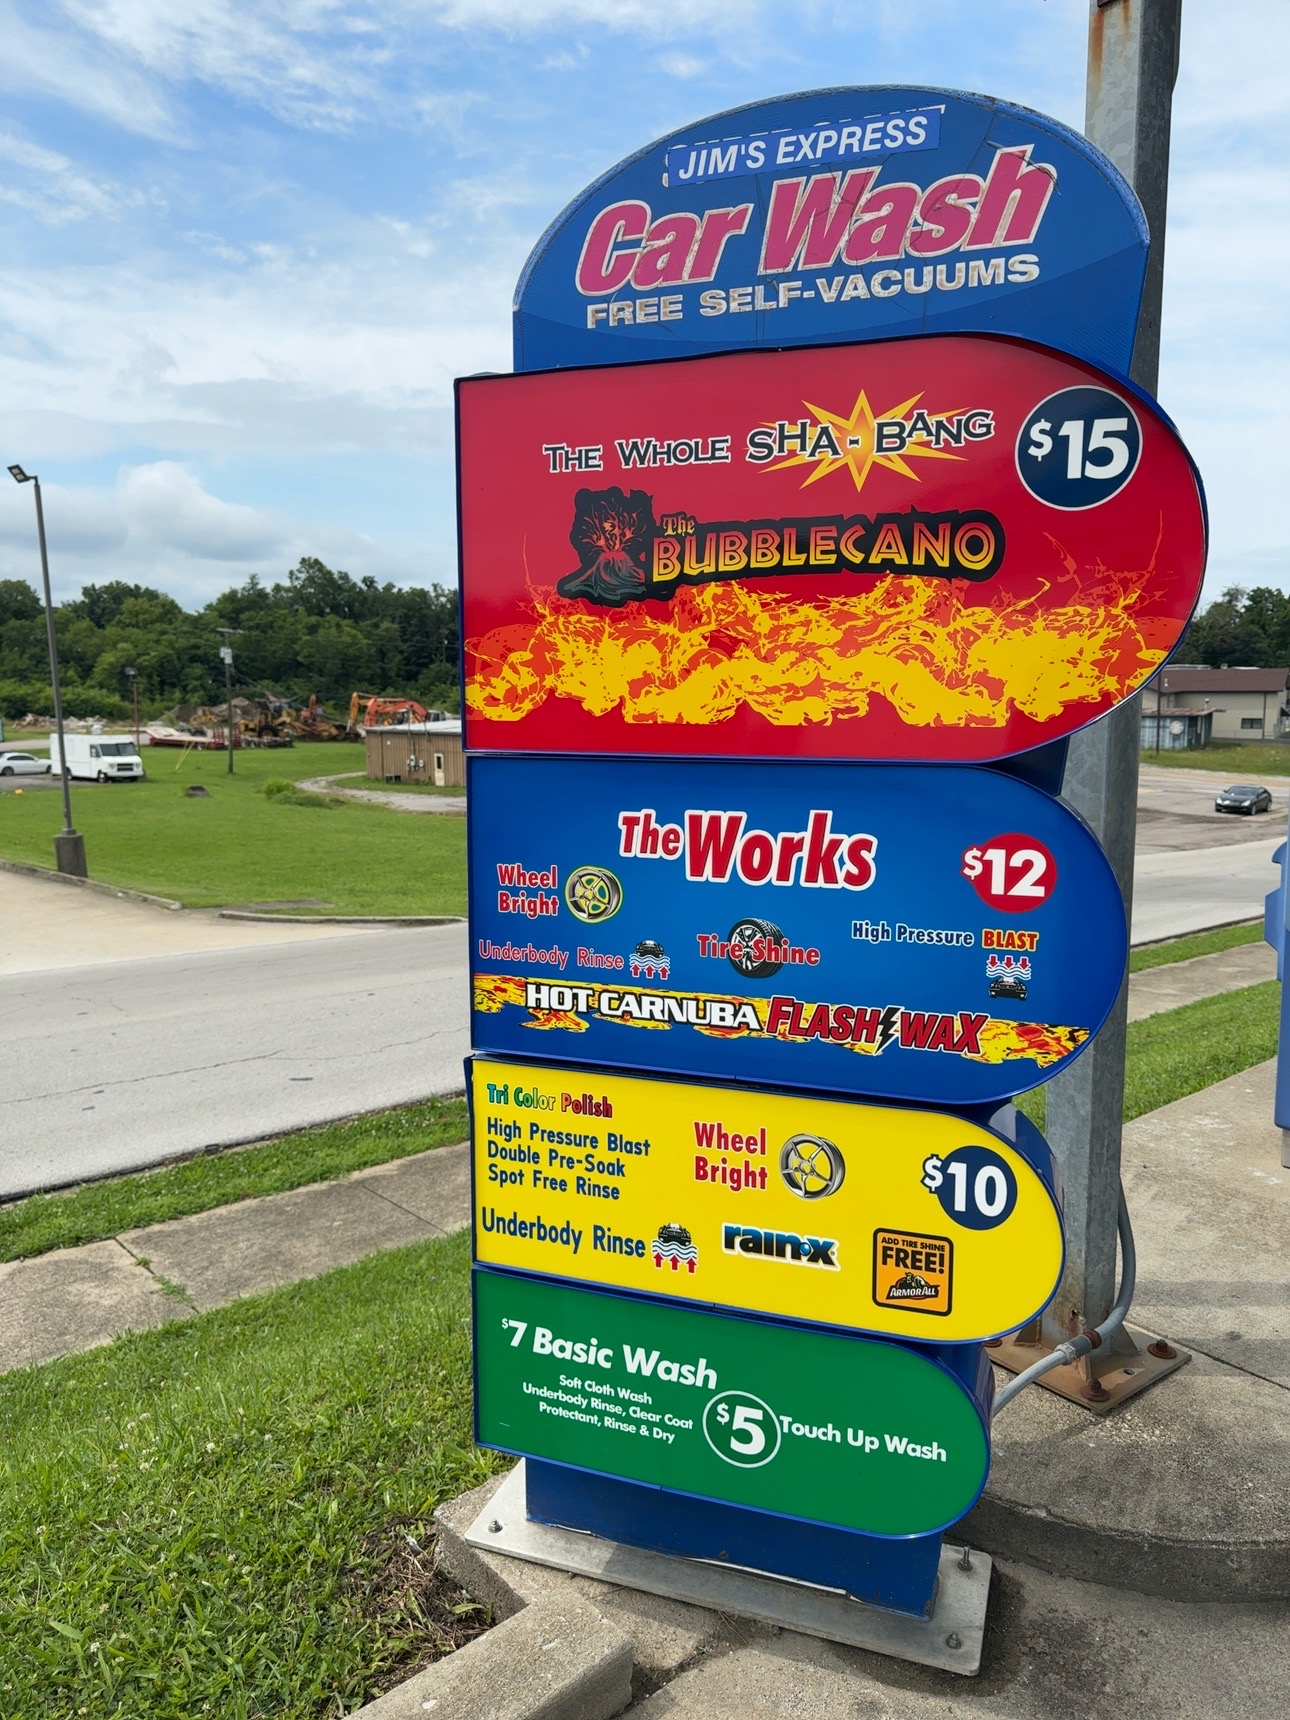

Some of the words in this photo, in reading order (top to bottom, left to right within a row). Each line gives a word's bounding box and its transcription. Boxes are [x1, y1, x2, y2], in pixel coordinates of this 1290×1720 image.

[677, 138, 766, 181] JIM'S
[774, 114, 929, 163] EXPRESS
[574, 199, 754, 297] Car
[757, 143, 1058, 276] Wash
[586, 295, 683, 330] FREE
[699, 253, 1041, 318] SELF-VACUUMS
[542, 442, 604, 475] THE
[615, 434, 732, 468] WHOLE
[1026, 416, 1130, 480] $15
[661, 514, 697, 537] The
[651, 522, 997, 584] BUBBLECANO
[617, 809, 684, 860] The
[684, 808, 878, 891] Works
[496, 863, 558, 889] Wheel
[962, 847, 1048, 898] $12
[497, 890, 559, 919] Bright
[478, 939, 569, 971] Underbody
[576, 946, 625, 970] Rinse
[696, 932, 744, 961] Tire
[751, 936, 821, 966] Shine
[851, 920, 892, 944] High
[895, 923, 975, 948] Pressure
[981, 929, 1039, 951] BLAST
[525, 981, 596, 1014] HOT
[598, 991, 763, 1030] CARNUBA
[766, 995, 883, 1043] FLASH
[898, 1010, 990, 1056] WAX
[486, 1083, 509, 1105] Tri
[513, 1087, 556, 1112] Color
[560, 1092, 613, 1118] Polish
[487, 1117, 522, 1141] High
[529, 1122, 599, 1150] Pressure
[607, 1132, 651, 1156] Blast
[693, 1121, 768, 1156] Wheel
[487, 1140, 541, 1165] Double
[549, 1148, 626, 1178] Pre-Soak
[694, 1155, 769, 1192] Bright
[488, 1164, 525, 1187] Spot
[532, 1169, 568, 1193] Free
[576, 1176, 620, 1200] Rinse
[923, 1154, 1009, 1218] $10
[482, 1207, 583, 1254] Underbody
[592, 1224, 646, 1258] Rinse
[881, 1236, 899, 1246] ADD
[900, 1239, 919, 1249] TIRE
[920, 1242, 946, 1253] SHINE
[881, 1246, 945, 1275] FREE!
[501, 1317, 528, 1347] $7
[532, 1326, 614, 1369] Basic
[622, 1344, 718, 1390] Wash
[522, 1381, 588, 1409] Underbody
[590, 1397, 627, 1417] Rinse,
[629, 1406, 662, 1423] Clear
[664, 1413, 694, 1430] Coat
[559, 1374, 582, 1390] Soft
[584, 1380, 615, 1397] Cloth
[617, 1386, 653, 1405] Wash
[539, 1401, 602, 1427] Protectant,
[604, 1416, 636, 1433] Rinse
[639, 1424, 650, 1437] &
[652, 1427, 676, 1444] Dry
[716, 1402, 766, 1455] $5
[779, 1415, 841, 1443] Touch
[847, 1428, 879, 1453] Up
[884, 1434, 947, 1462] Wash
